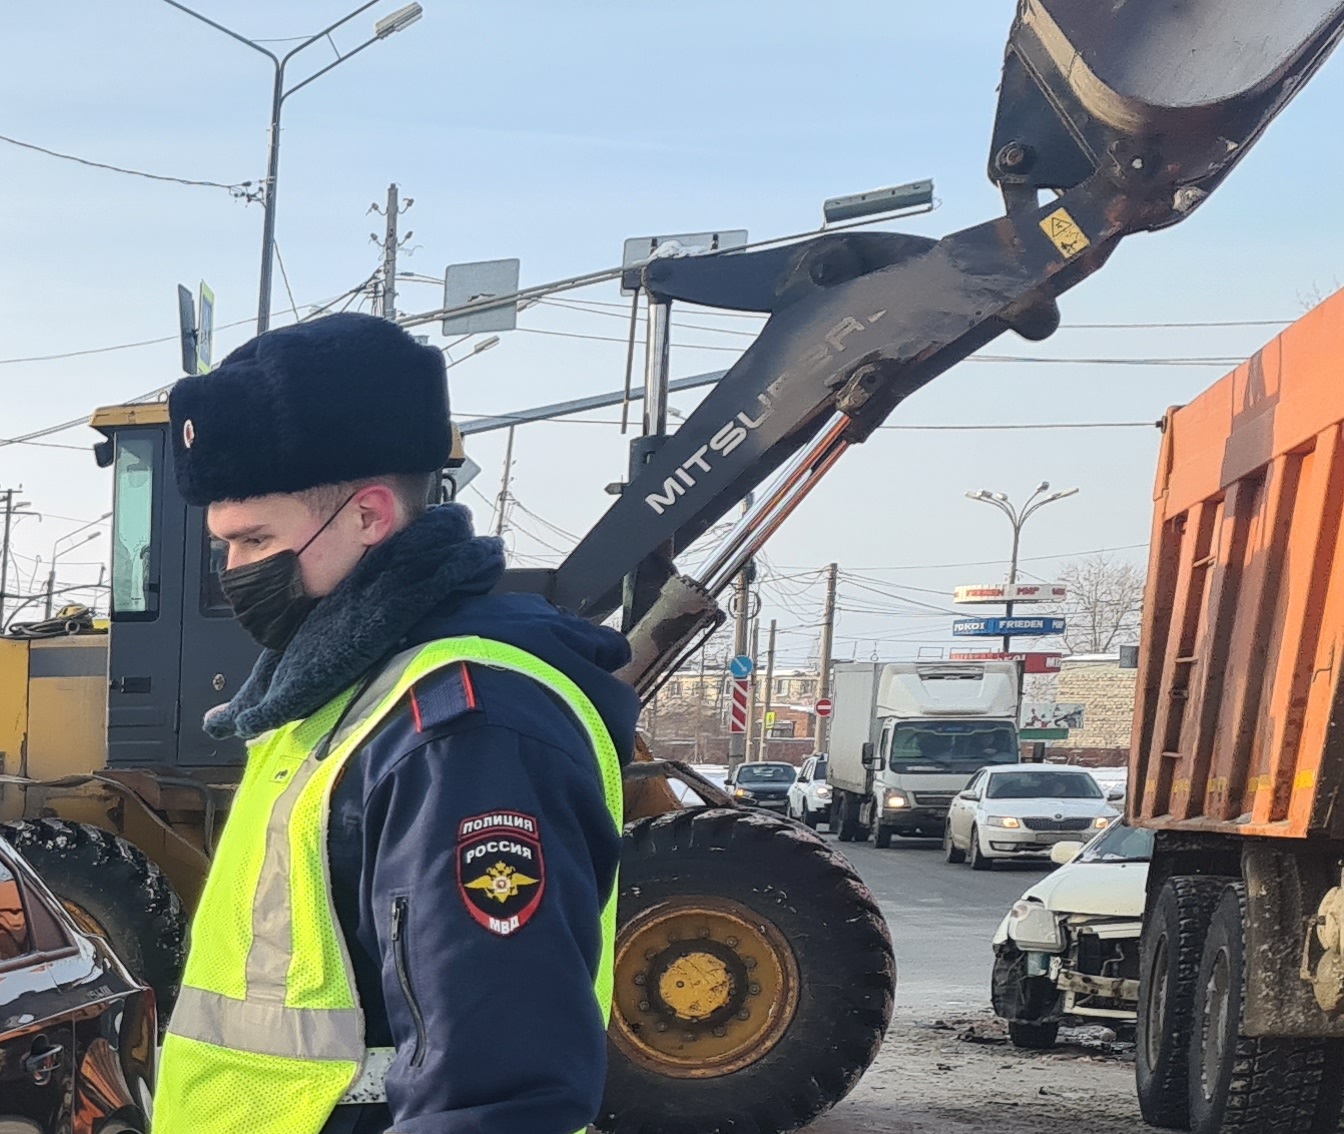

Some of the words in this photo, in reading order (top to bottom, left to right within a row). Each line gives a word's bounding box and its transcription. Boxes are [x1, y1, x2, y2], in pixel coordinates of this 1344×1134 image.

[463, 815, 534, 834] ПОЛИЦИЯ
[466, 841, 532, 863] РОССИЯ
[489, 915, 520, 934] МВД
